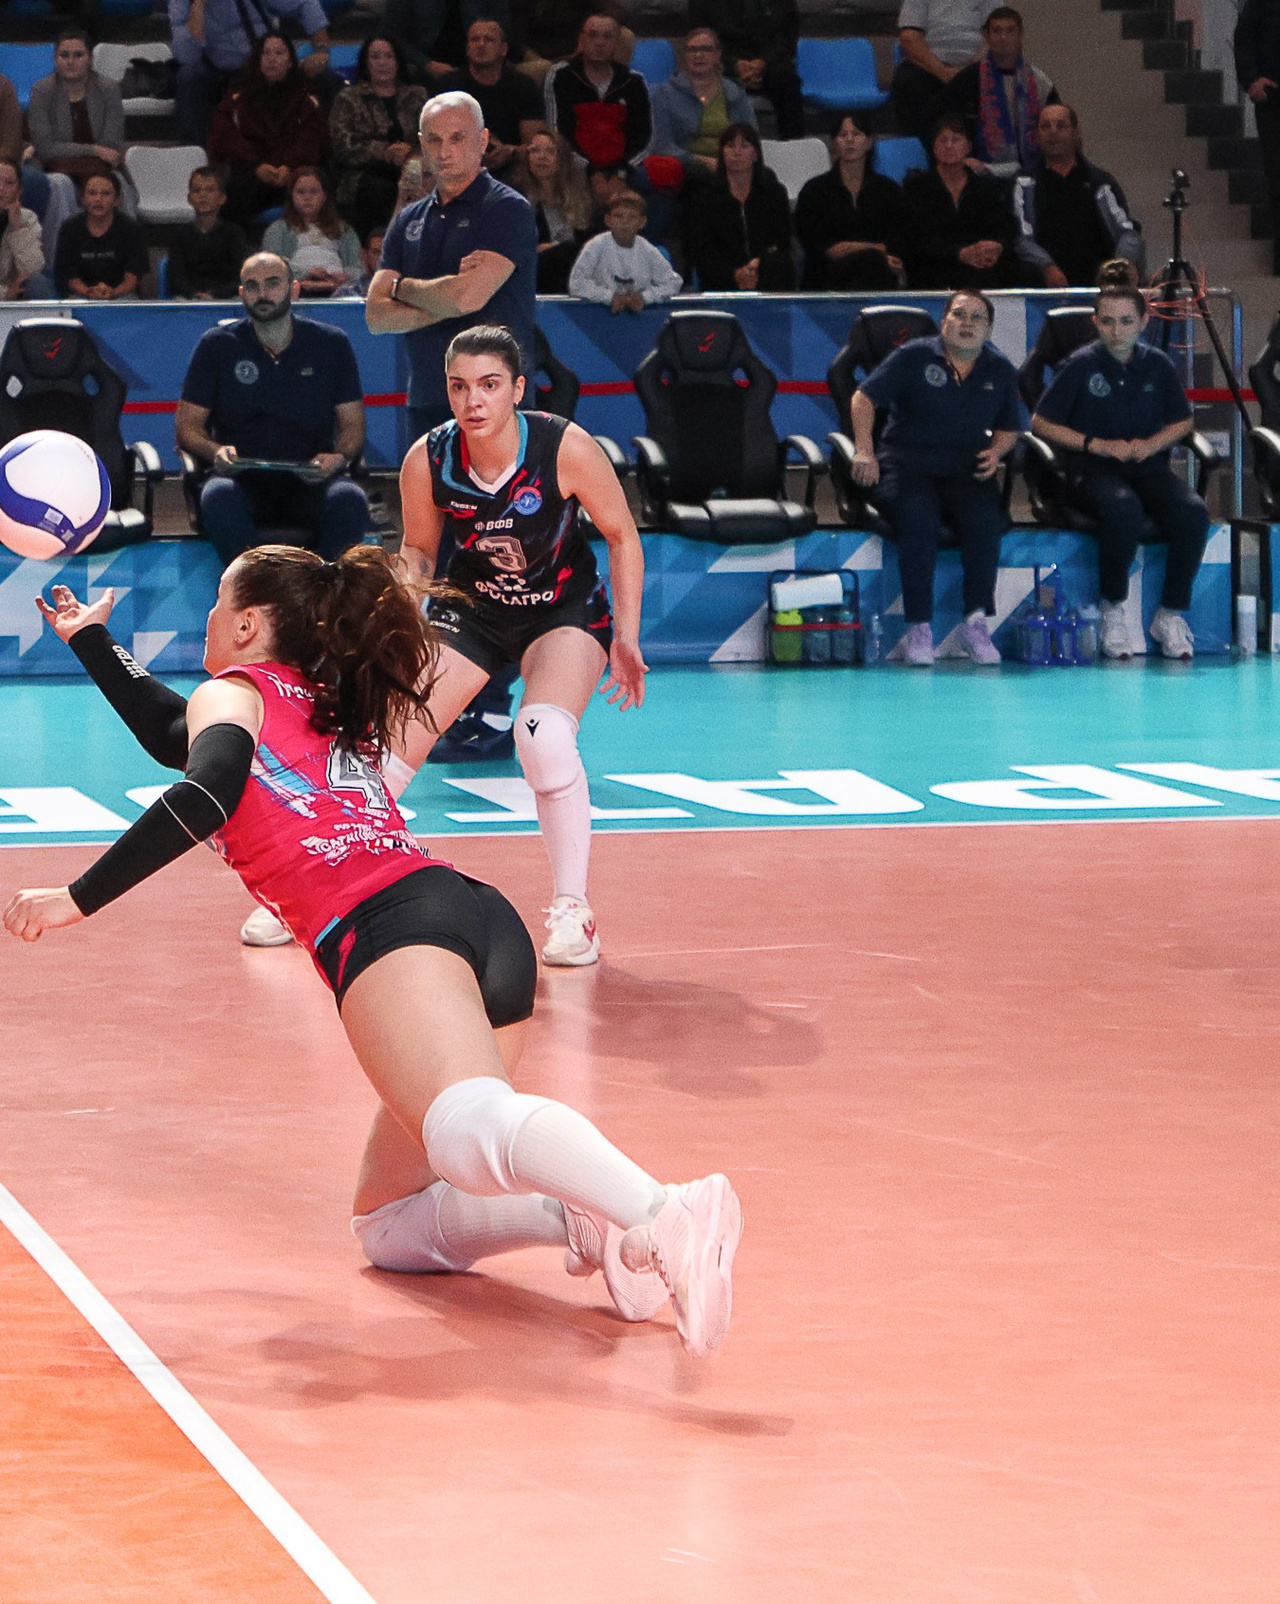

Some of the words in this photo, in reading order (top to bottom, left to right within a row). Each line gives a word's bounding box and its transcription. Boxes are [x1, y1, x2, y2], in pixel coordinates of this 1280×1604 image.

[485, 518, 514, 531] ВФВ
[475, 535, 527, 572] 3
[326, 738, 391, 812] 4
